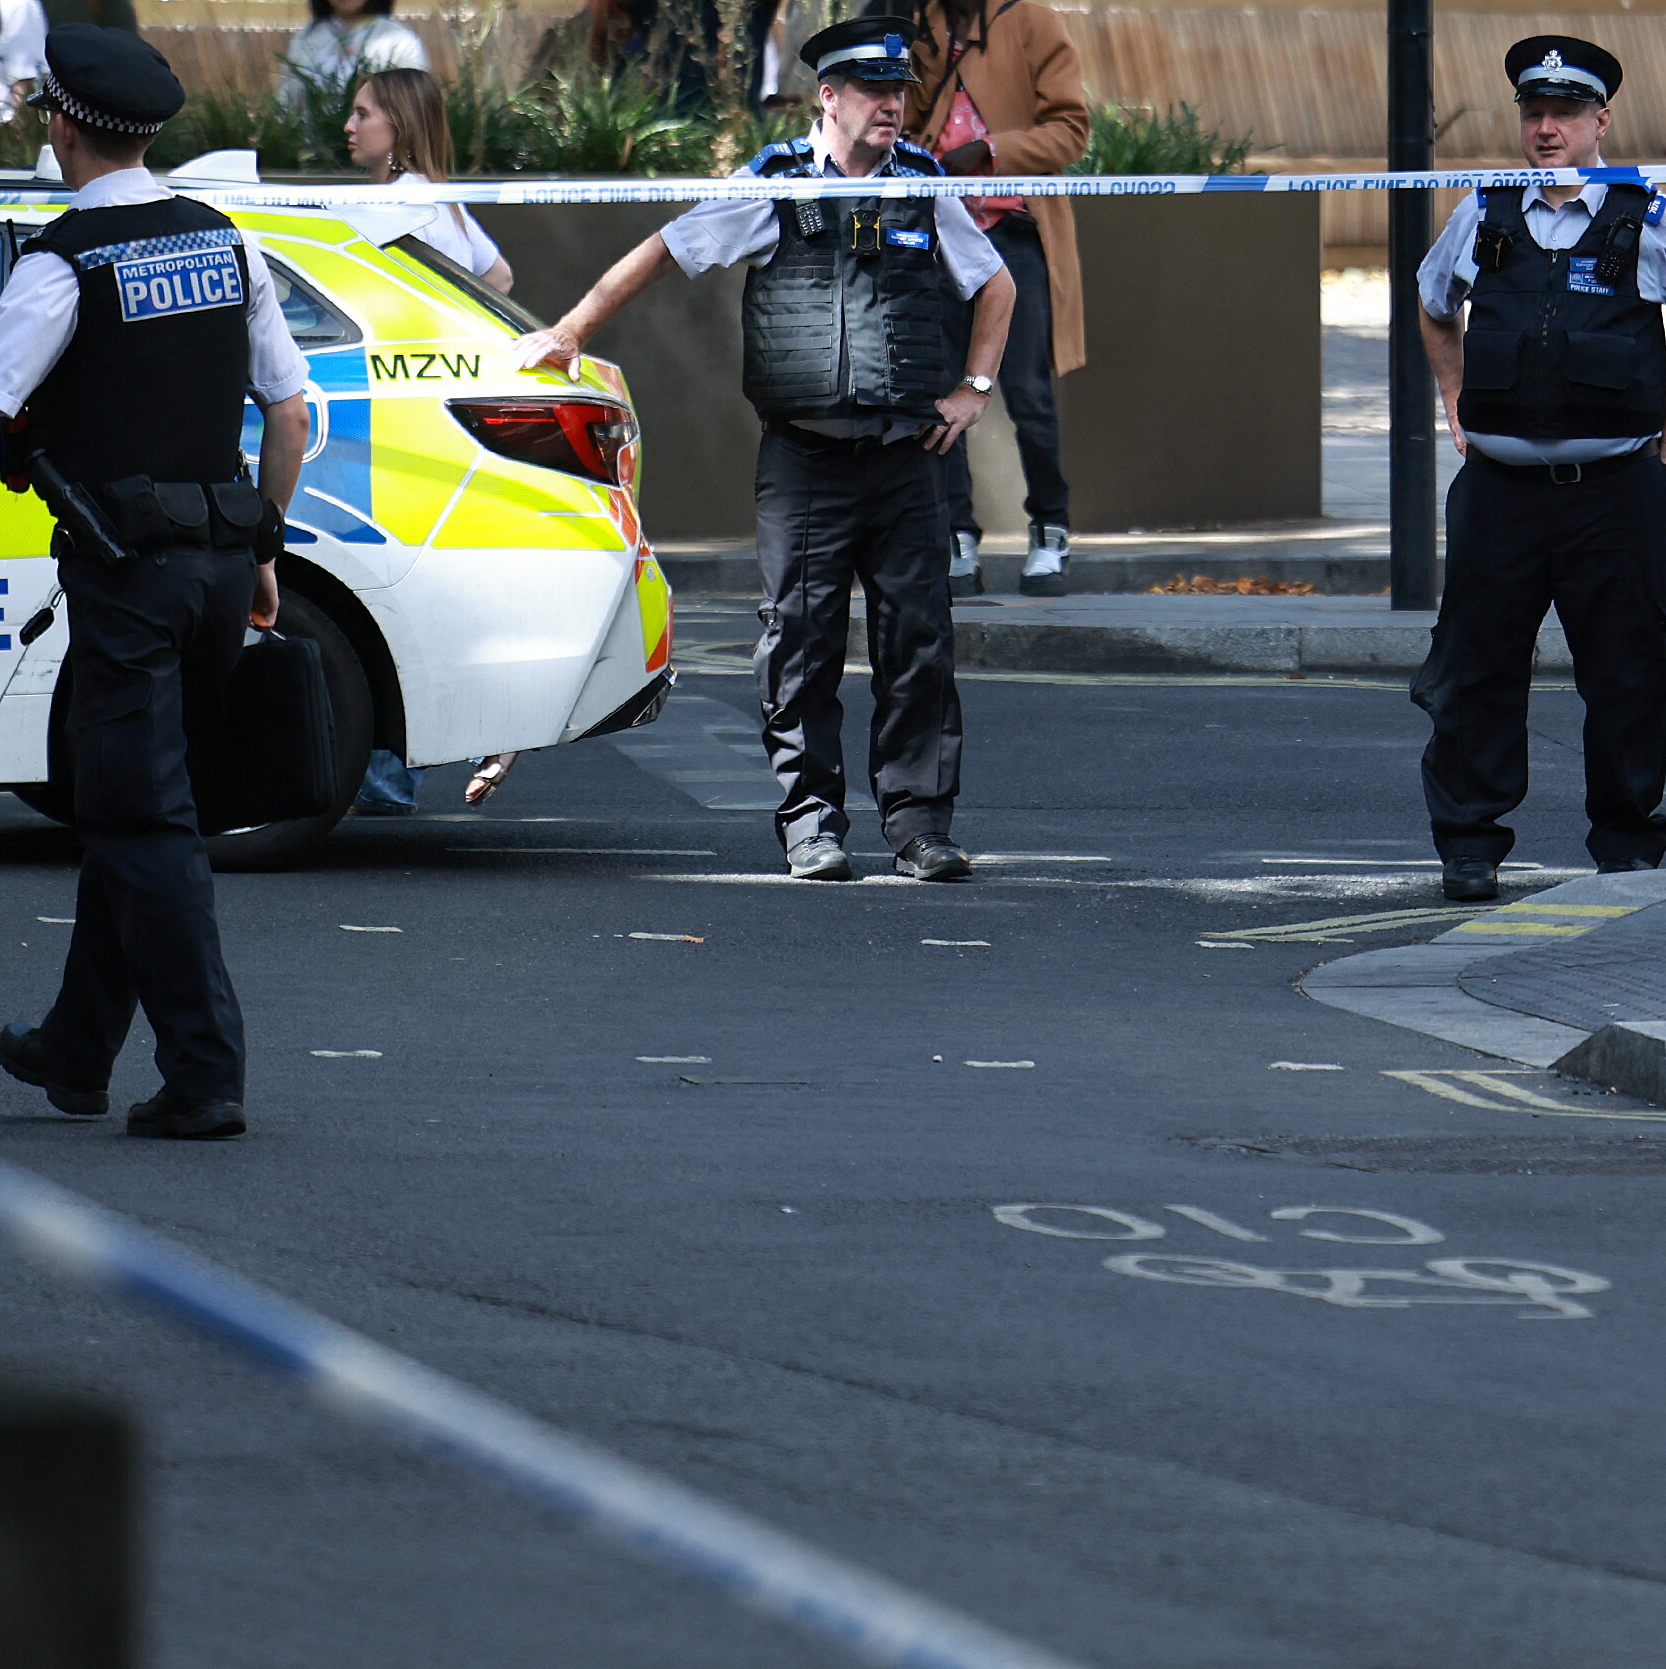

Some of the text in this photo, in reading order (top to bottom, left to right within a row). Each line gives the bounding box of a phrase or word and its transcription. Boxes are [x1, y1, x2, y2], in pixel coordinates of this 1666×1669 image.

[122, 252, 233, 279] METROPOLITAN
[124, 267, 240, 314] POLICE
[1570, 283, 1610, 295] POLICE STAFF
[369, 353, 481, 381] MZW
